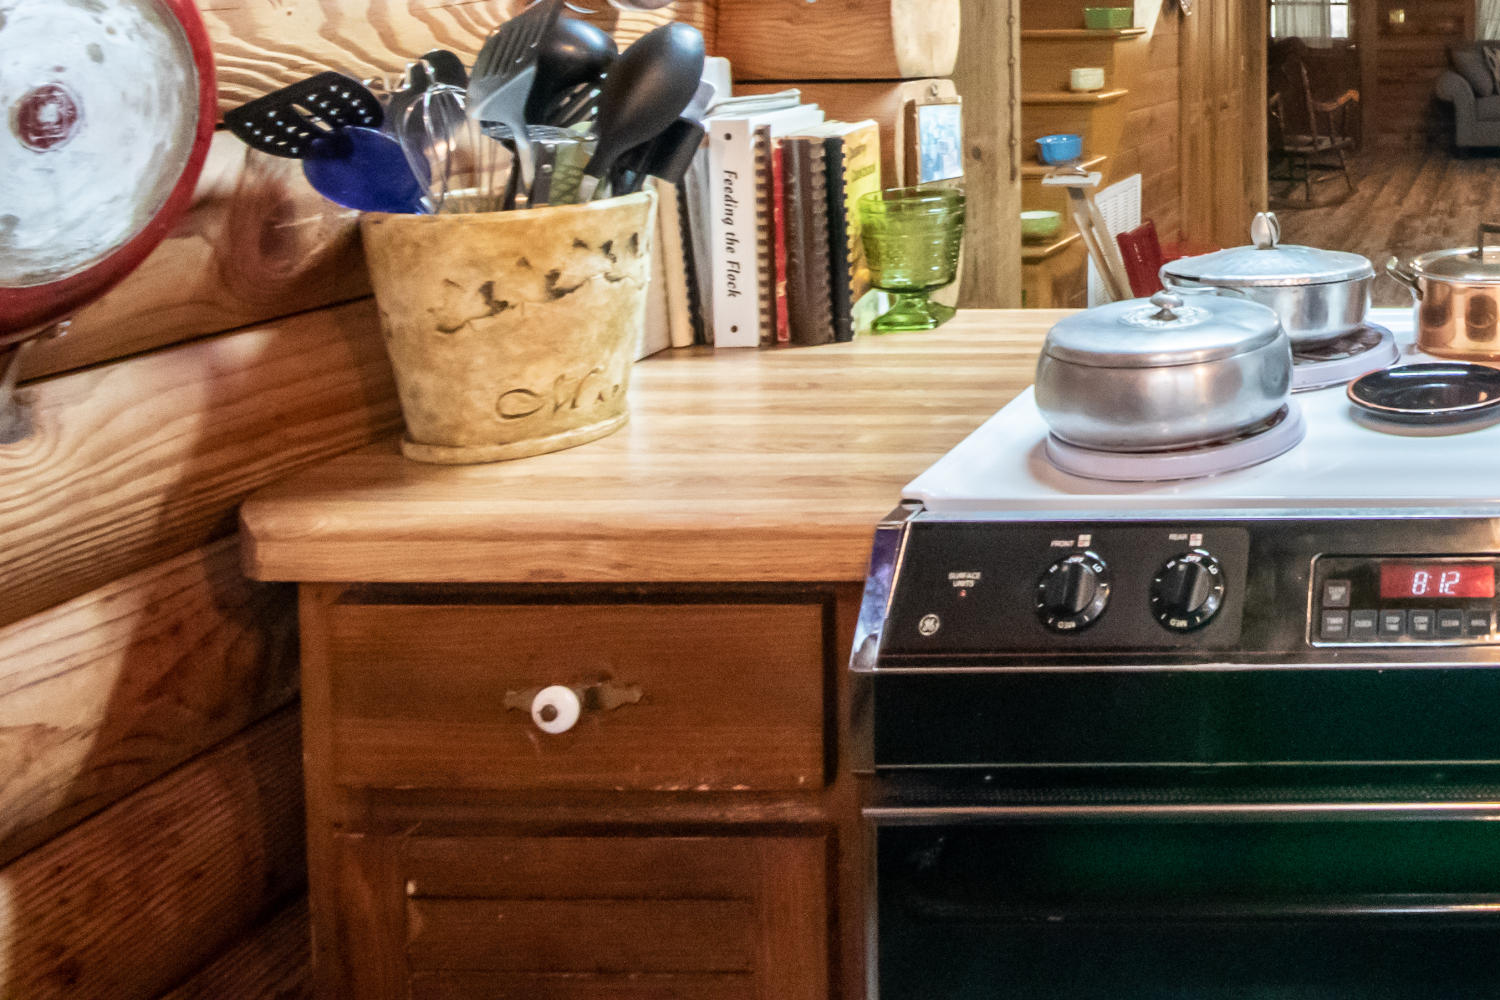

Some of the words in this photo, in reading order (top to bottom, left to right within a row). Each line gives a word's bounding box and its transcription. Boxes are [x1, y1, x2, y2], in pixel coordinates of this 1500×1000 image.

[721, 170, 739, 226] Feeding
[725, 232, 740, 254] the
[726, 260, 742, 298] Flock
